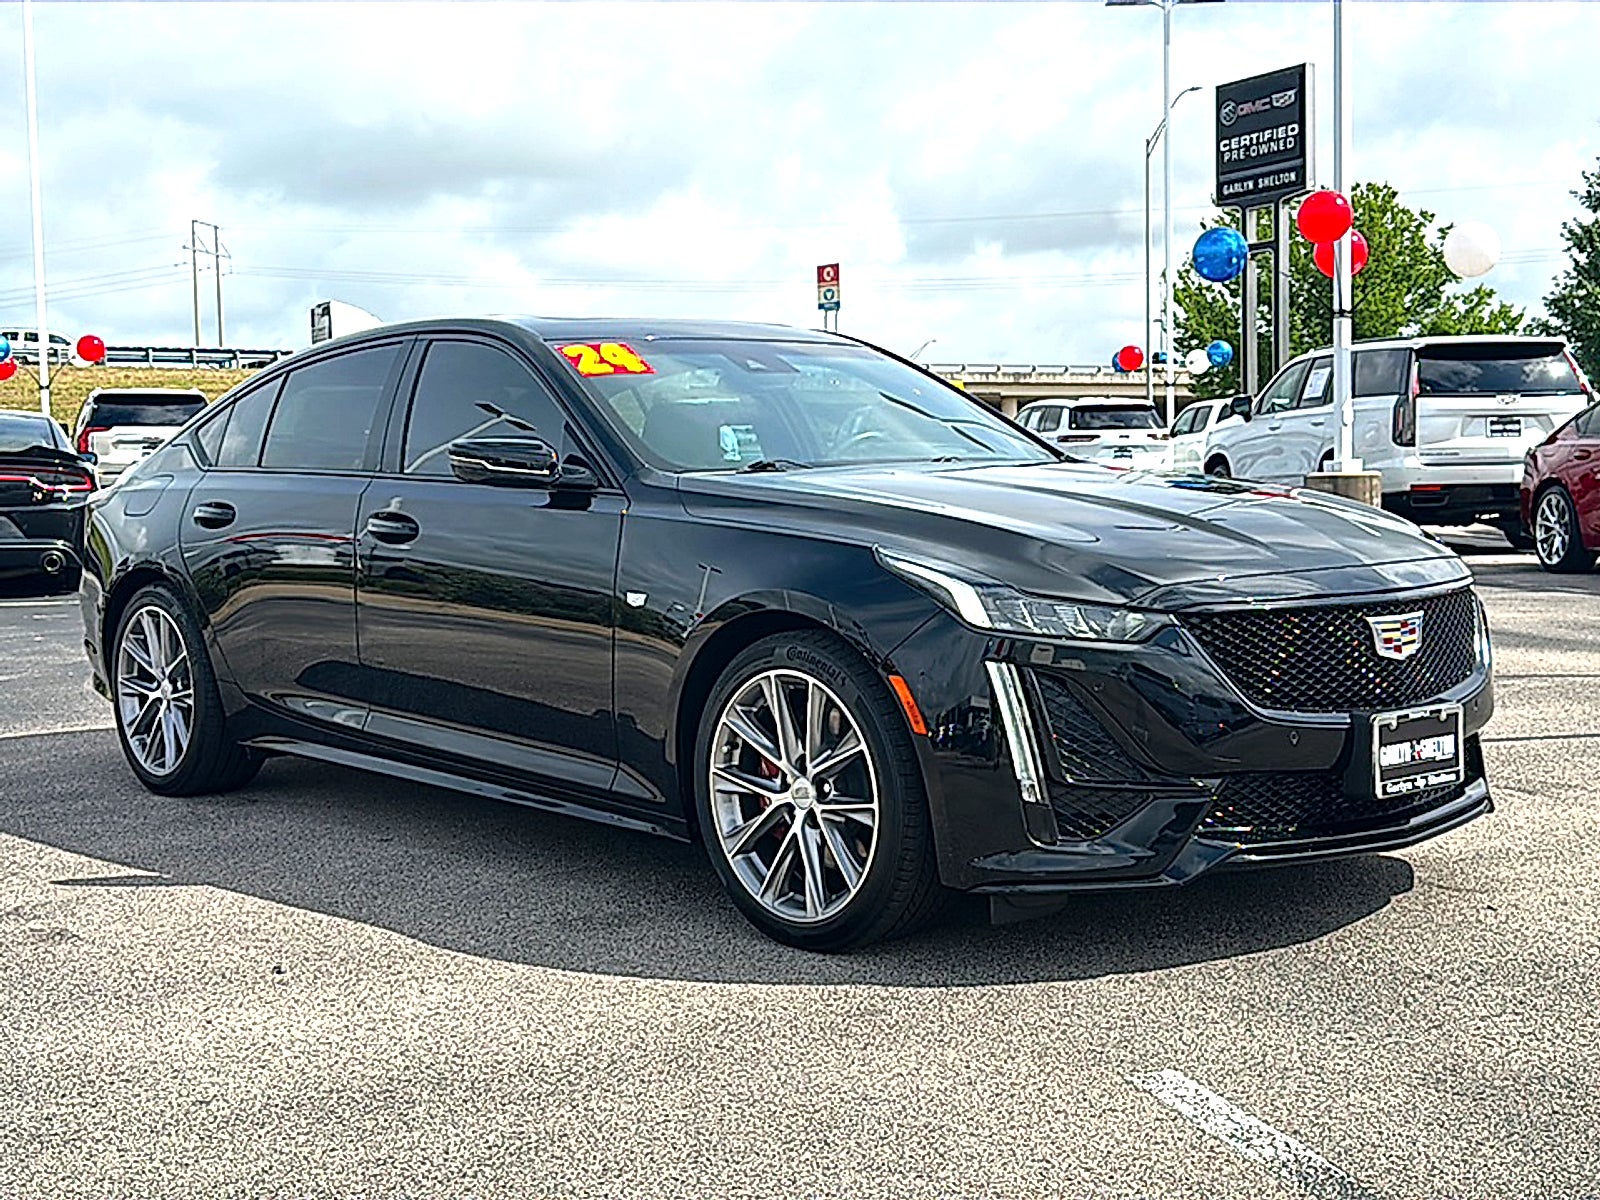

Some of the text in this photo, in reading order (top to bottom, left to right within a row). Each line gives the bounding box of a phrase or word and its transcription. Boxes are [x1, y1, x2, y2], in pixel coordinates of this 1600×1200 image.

[1238, 98, 1271, 116] GMC
[1220, 123, 1299, 151] CERTIFIED
[1223, 137, 1295, 163] PRE-OWNED
[1258, 171, 1297, 189] SHELTON
[562, 343, 647, 374] 24
[786, 645, 842, 682] Continental
